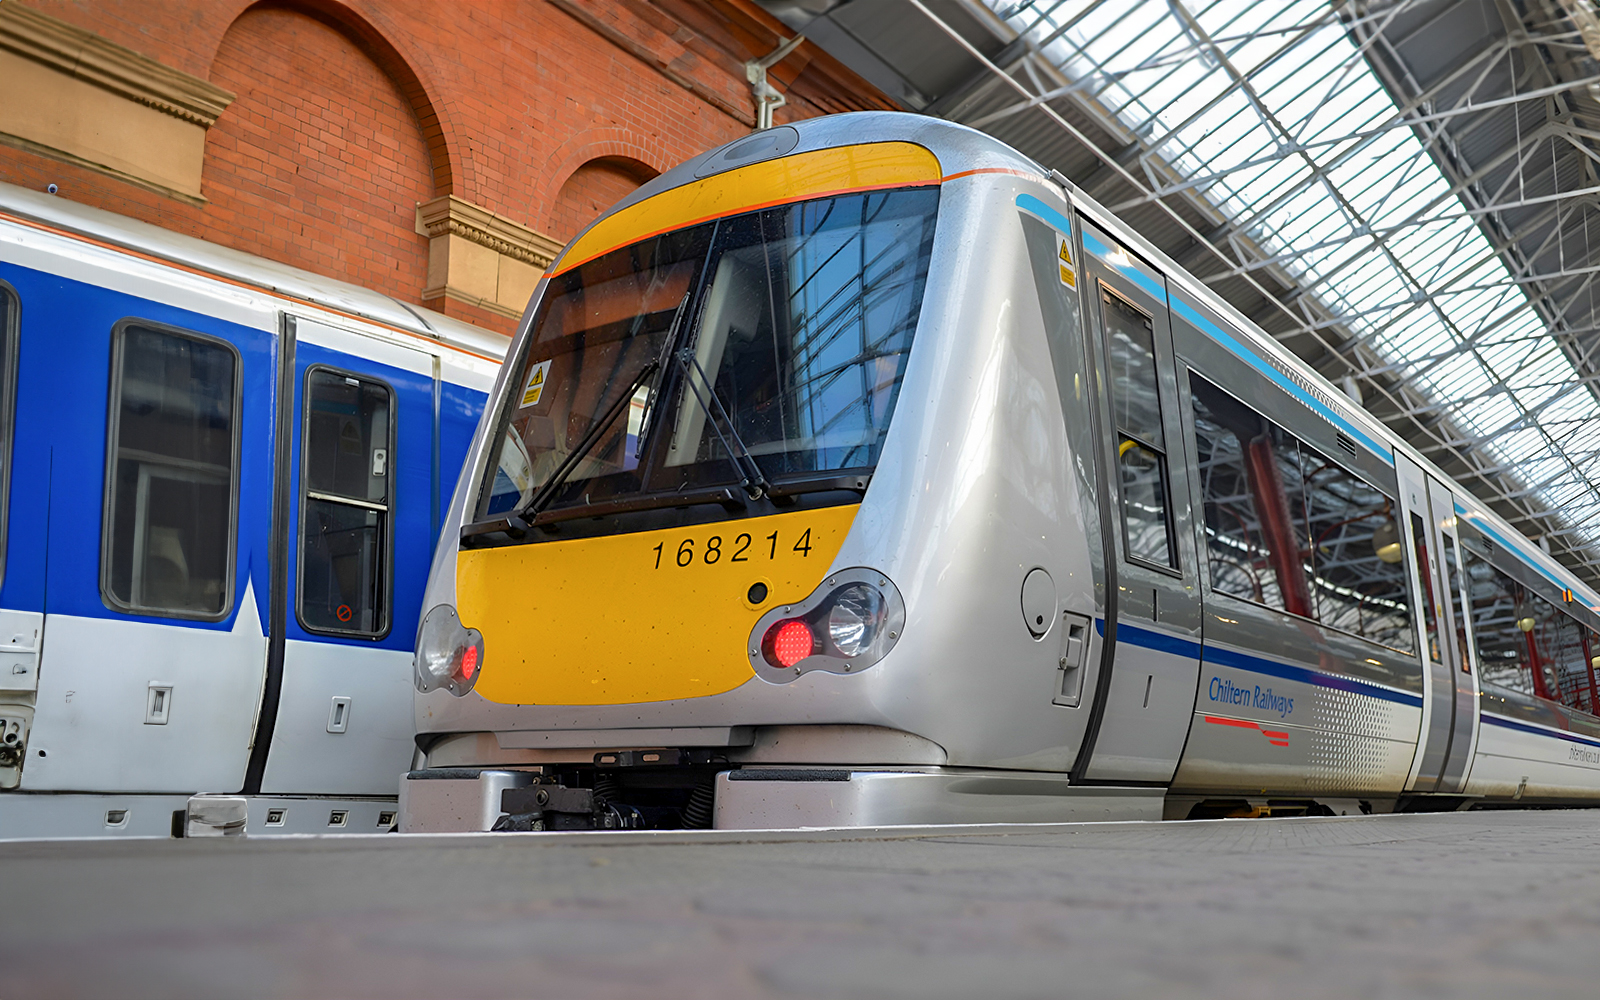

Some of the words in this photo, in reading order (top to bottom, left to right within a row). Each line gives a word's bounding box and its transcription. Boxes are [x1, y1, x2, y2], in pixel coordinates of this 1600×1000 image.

[652, 528, 812, 569] 168214
[1209, 676, 1250, 706] Chiltern
[1252, 685, 1295, 718] Railways
